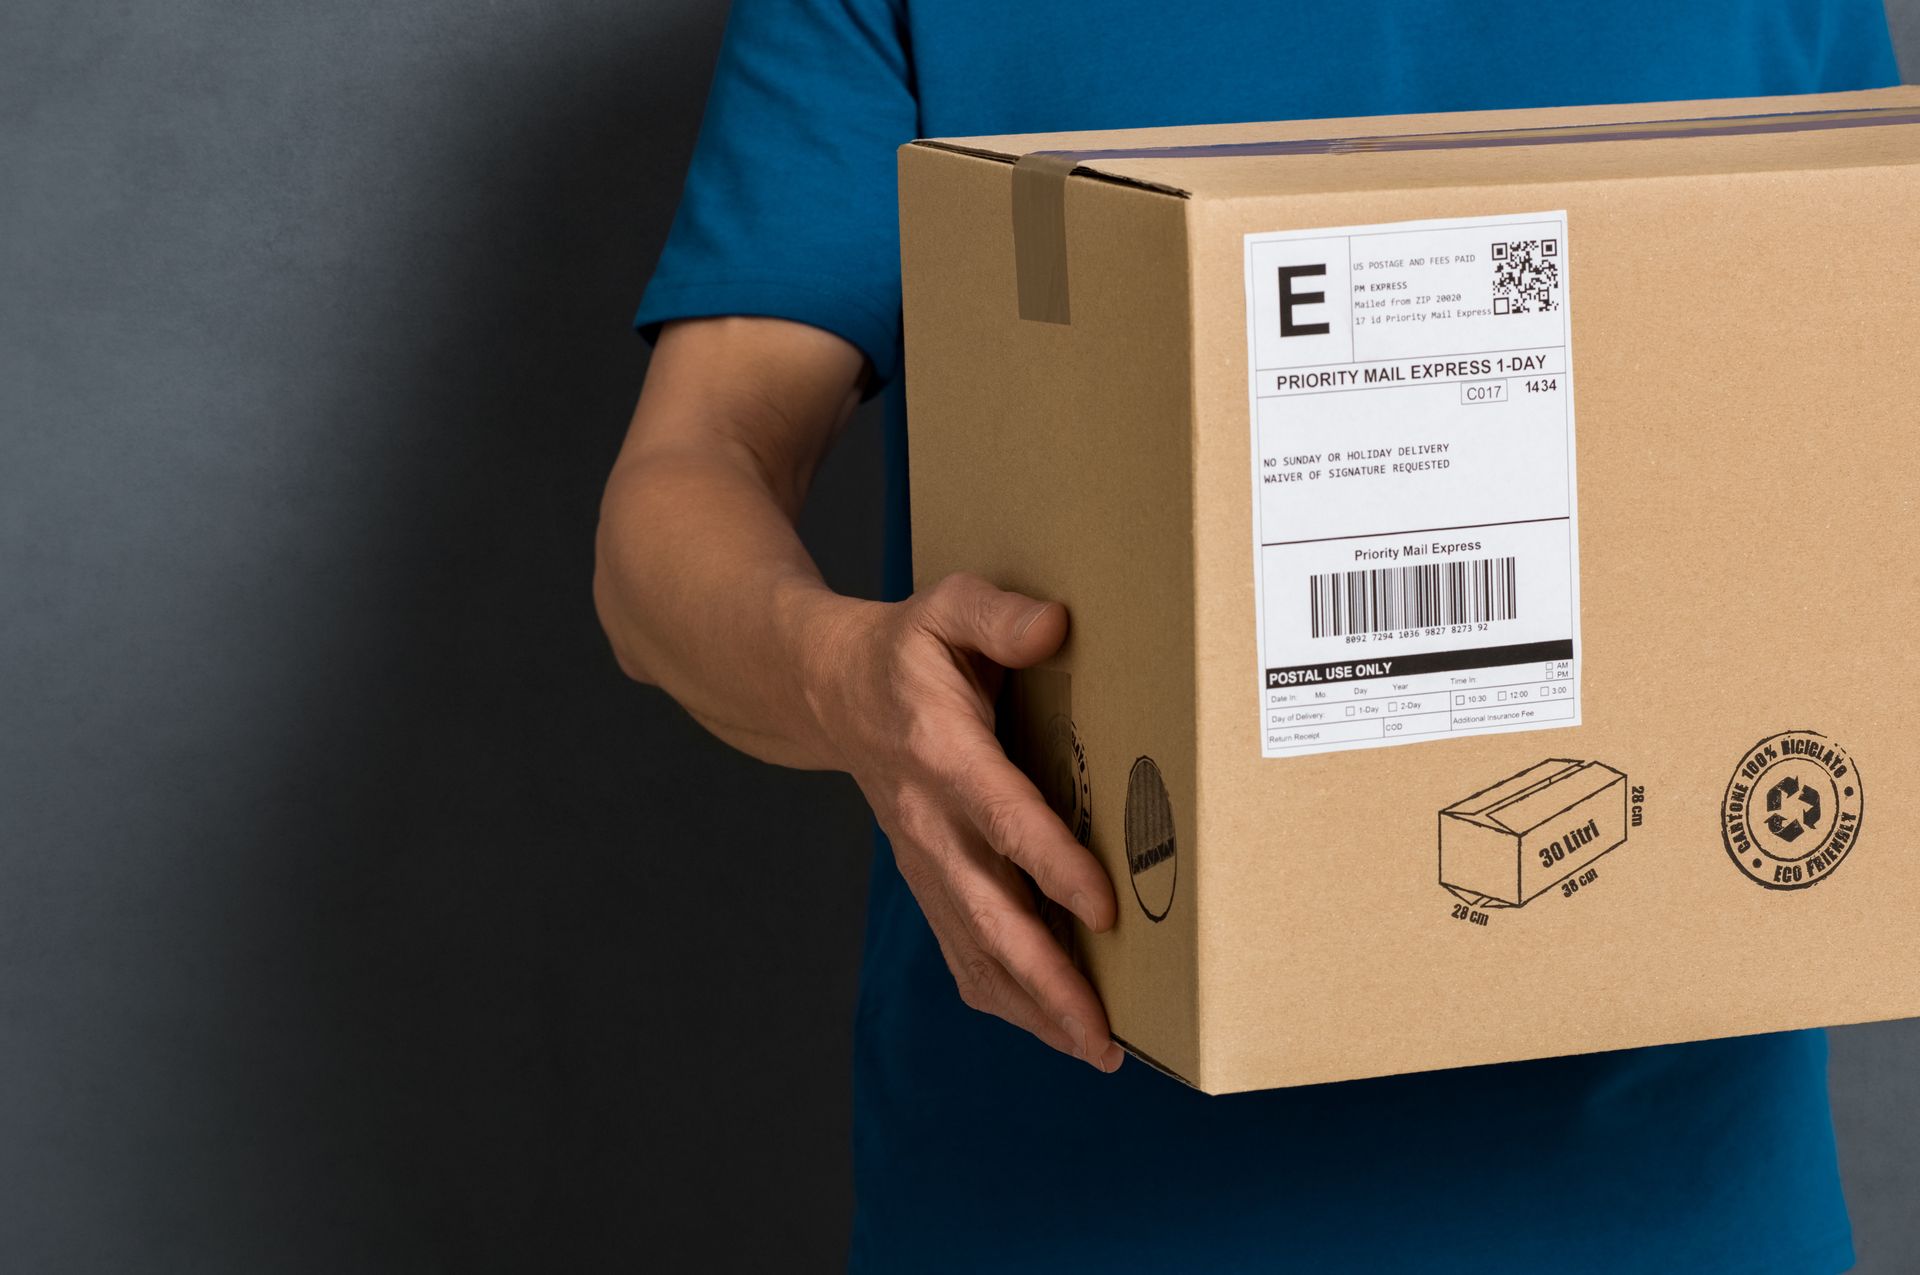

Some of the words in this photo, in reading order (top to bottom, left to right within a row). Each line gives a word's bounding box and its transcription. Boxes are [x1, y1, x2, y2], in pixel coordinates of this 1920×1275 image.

[1354, 262, 1364, 270] US
[1369, 260, 1404, 270] POSTAGE
[1409, 258, 1424, 266] AND
[1430, 256, 1450, 265] FEES
[1455, 254, 1476, 263] PAID
[1370, 282, 1408, 291] EXPRESS
[1278, 264, 1330, 337] E
[1354, 298, 1386, 309] Mailed
[1391, 298, 1411, 306] from
[1416, 296, 1430, 304] ZIP
[1436, 294, 1462, 303] 20020
[1356, 317, 1365, 325] 17
[1386, 312, 1426, 323] Priority
[1432, 310, 1452, 320] Mail
[1456, 308, 1492, 318] Express
[1277, 370, 1359, 390] PRIORITY
[1364, 366, 1406, 383] MAIL
[1411, 360, 1492, 380] EXPRESS
[1497, 355, 1547, 373] 1-DAY
[1467, 386, 1502, 400] C017
[1526, 379, 1557, 393] 1434
[1264, 459, 1276, 468] NO
[1283, 454, 1322, 466] SUNDAY
[1328, 452, 1340, 462] OR
[1348, 448, 1392, 460] HOLIDAY
[1398, 444, 1450, 456] DELIVERY
[1264, 472, 1302, 484] WAIVER
[1309, 470, 1322, 480] OF
[1329, 465, 1386, 478] SIGNATURE
[1393, 460, 1450, 473] REQUESTED
[1354, 548, 1399, 560] Priority
[1403, 544, 1428, 556] Mail
[1432, 542, 1482, 555] Express
[1346, 635, 1366, 644] 8092
[1372, 632, 1394, 641] 7294
[1399, 630, 1420, 639] 1036
[1425, 627, 1446, 636] 9827
[1452, 624, 1472, 634] 8273
[1478, 623, 1488, 632] 92
[1269, 669, 1322, 686] POSTAL
[1326, 666, 1352, 680] USE
[1356, 662, 1392, 676] ONLY
[1271, 694, 1287, 703] Date
[1354, 687, 1368, 696] Day
[1359, 705, 1379, 714] 1-Day
[1400, 702, 1422, 710] 2-Day
[1453, 714, 1486, 724] Additional
[1487, 712, 1519, 721] Insurance
[1272, 715, 1286, 724] Day
[1386, 723, 1402, 732] COD
[1742, 744, 1778, 780] 100%
[1632, 786, 1644, 802] 28
[1631, 805, 1642, 827] cm
[1538, 841, 1565, 868] 30
[1562, 818, 1600, 854] Litri
[1774, 865, 1802, 883] ECO
[1806, 812, 1856, 878] FRIENDLY
[1561, 880, 1579, 898] 38
[1578, 868, 1598, 886] cm
[1451, 904, 1469, 919] 28
[1470, 911, 1490, 926] cm
